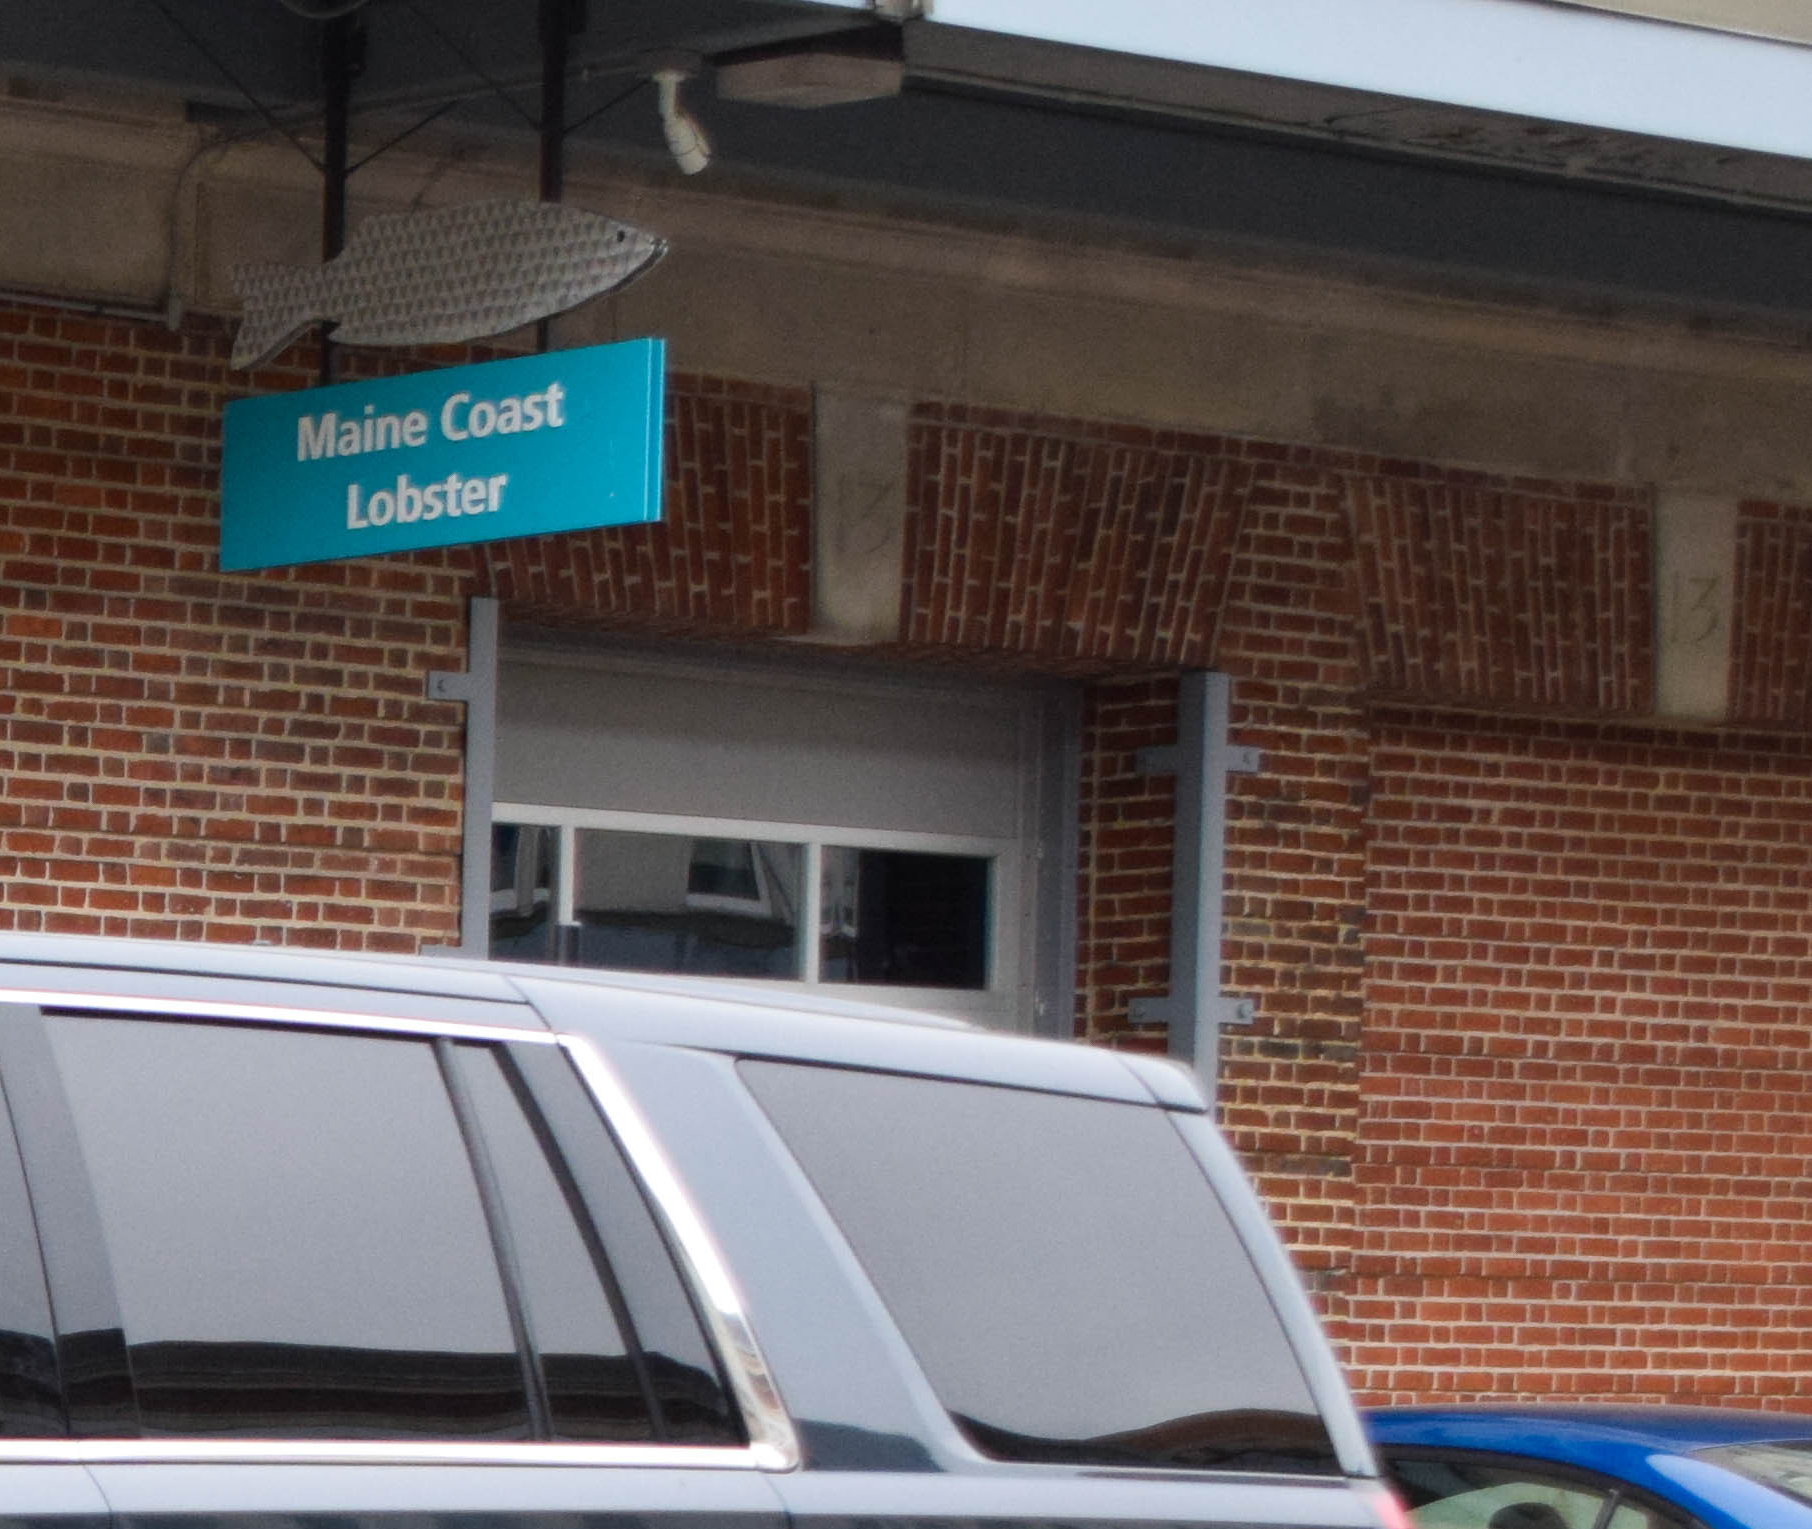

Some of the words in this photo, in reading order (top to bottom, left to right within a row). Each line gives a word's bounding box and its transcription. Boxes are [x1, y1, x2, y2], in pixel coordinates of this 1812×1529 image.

[296, 404, 427, 462] Maine
[440, 381, 567, 441] Coast
[346, 473, 509, 530] Lobster
